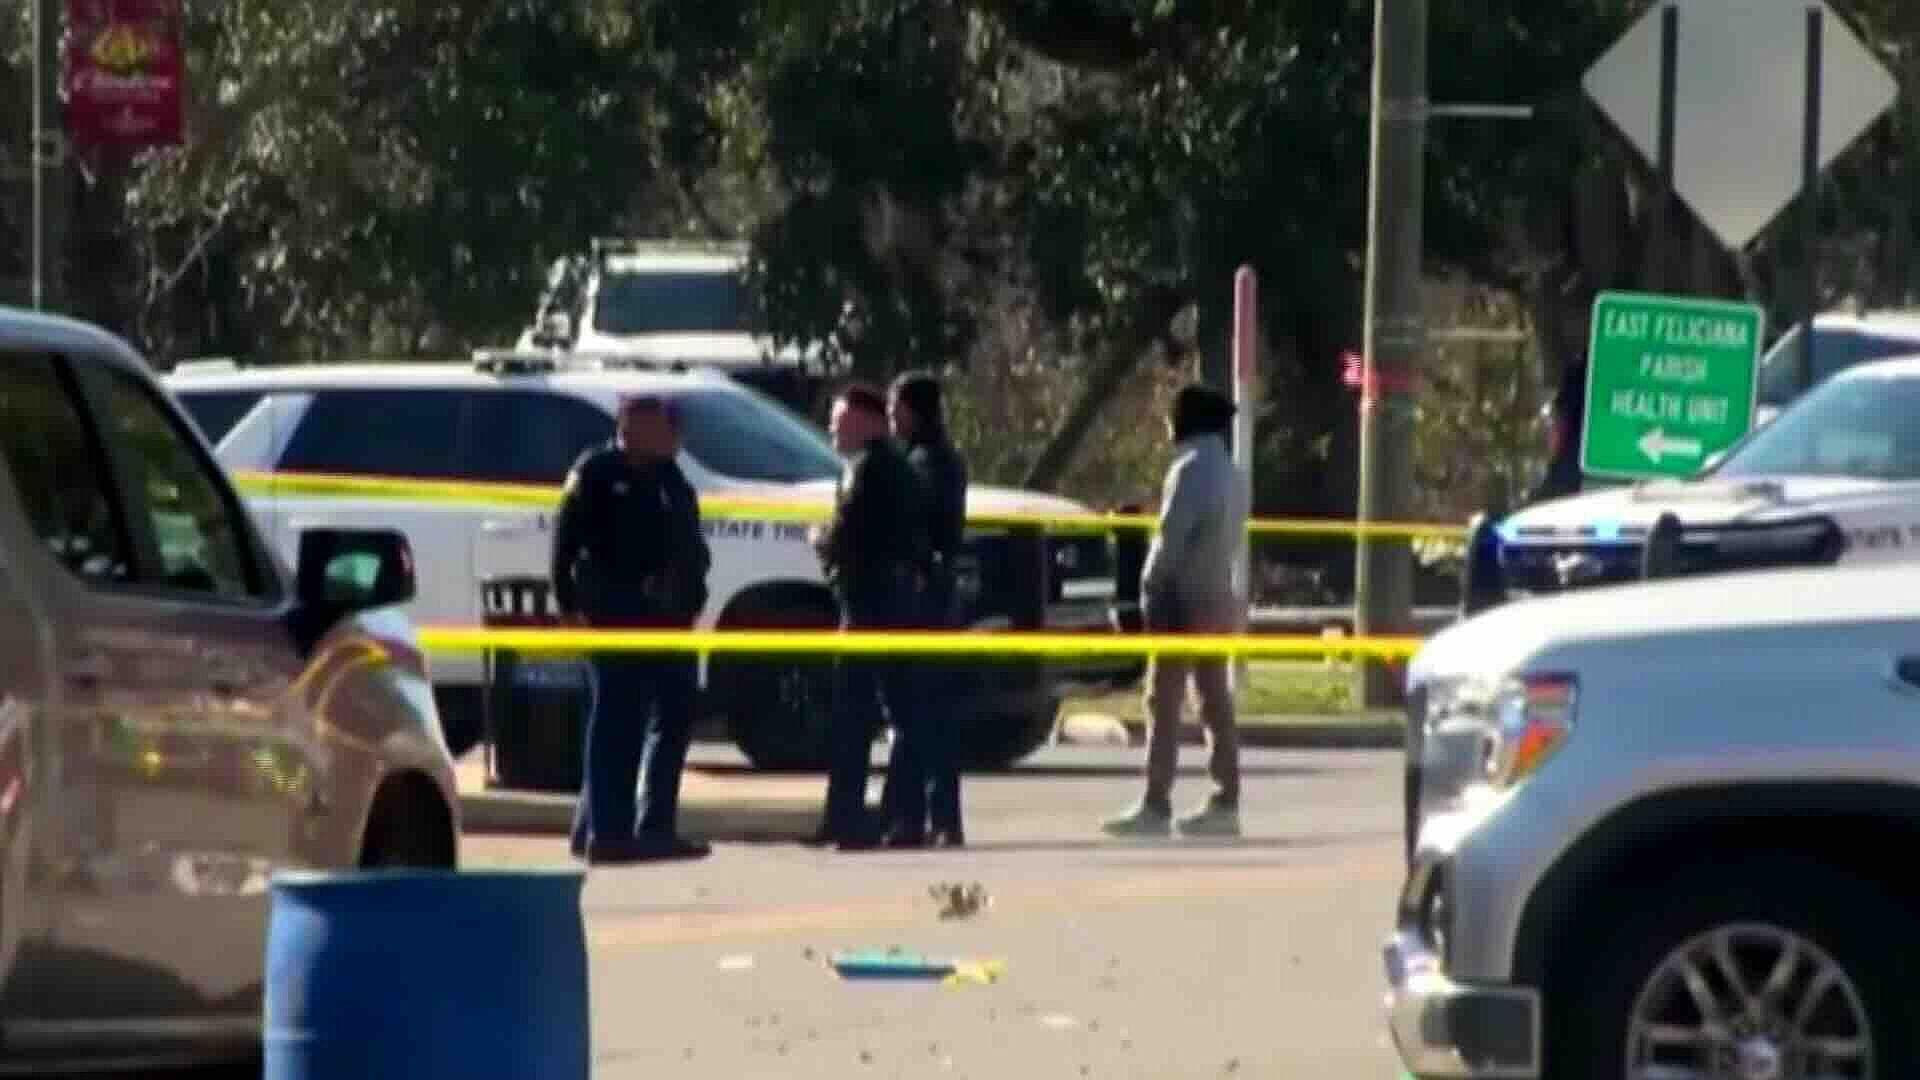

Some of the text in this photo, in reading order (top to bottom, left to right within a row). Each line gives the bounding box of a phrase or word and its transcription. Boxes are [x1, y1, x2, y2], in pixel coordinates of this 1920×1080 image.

[1605, 309, 1748, 346] EAST FELICIANA
[1640, 353, 1708, 382] PARISH
[1611, 389, 1729, 424] HEALTH UNIT
